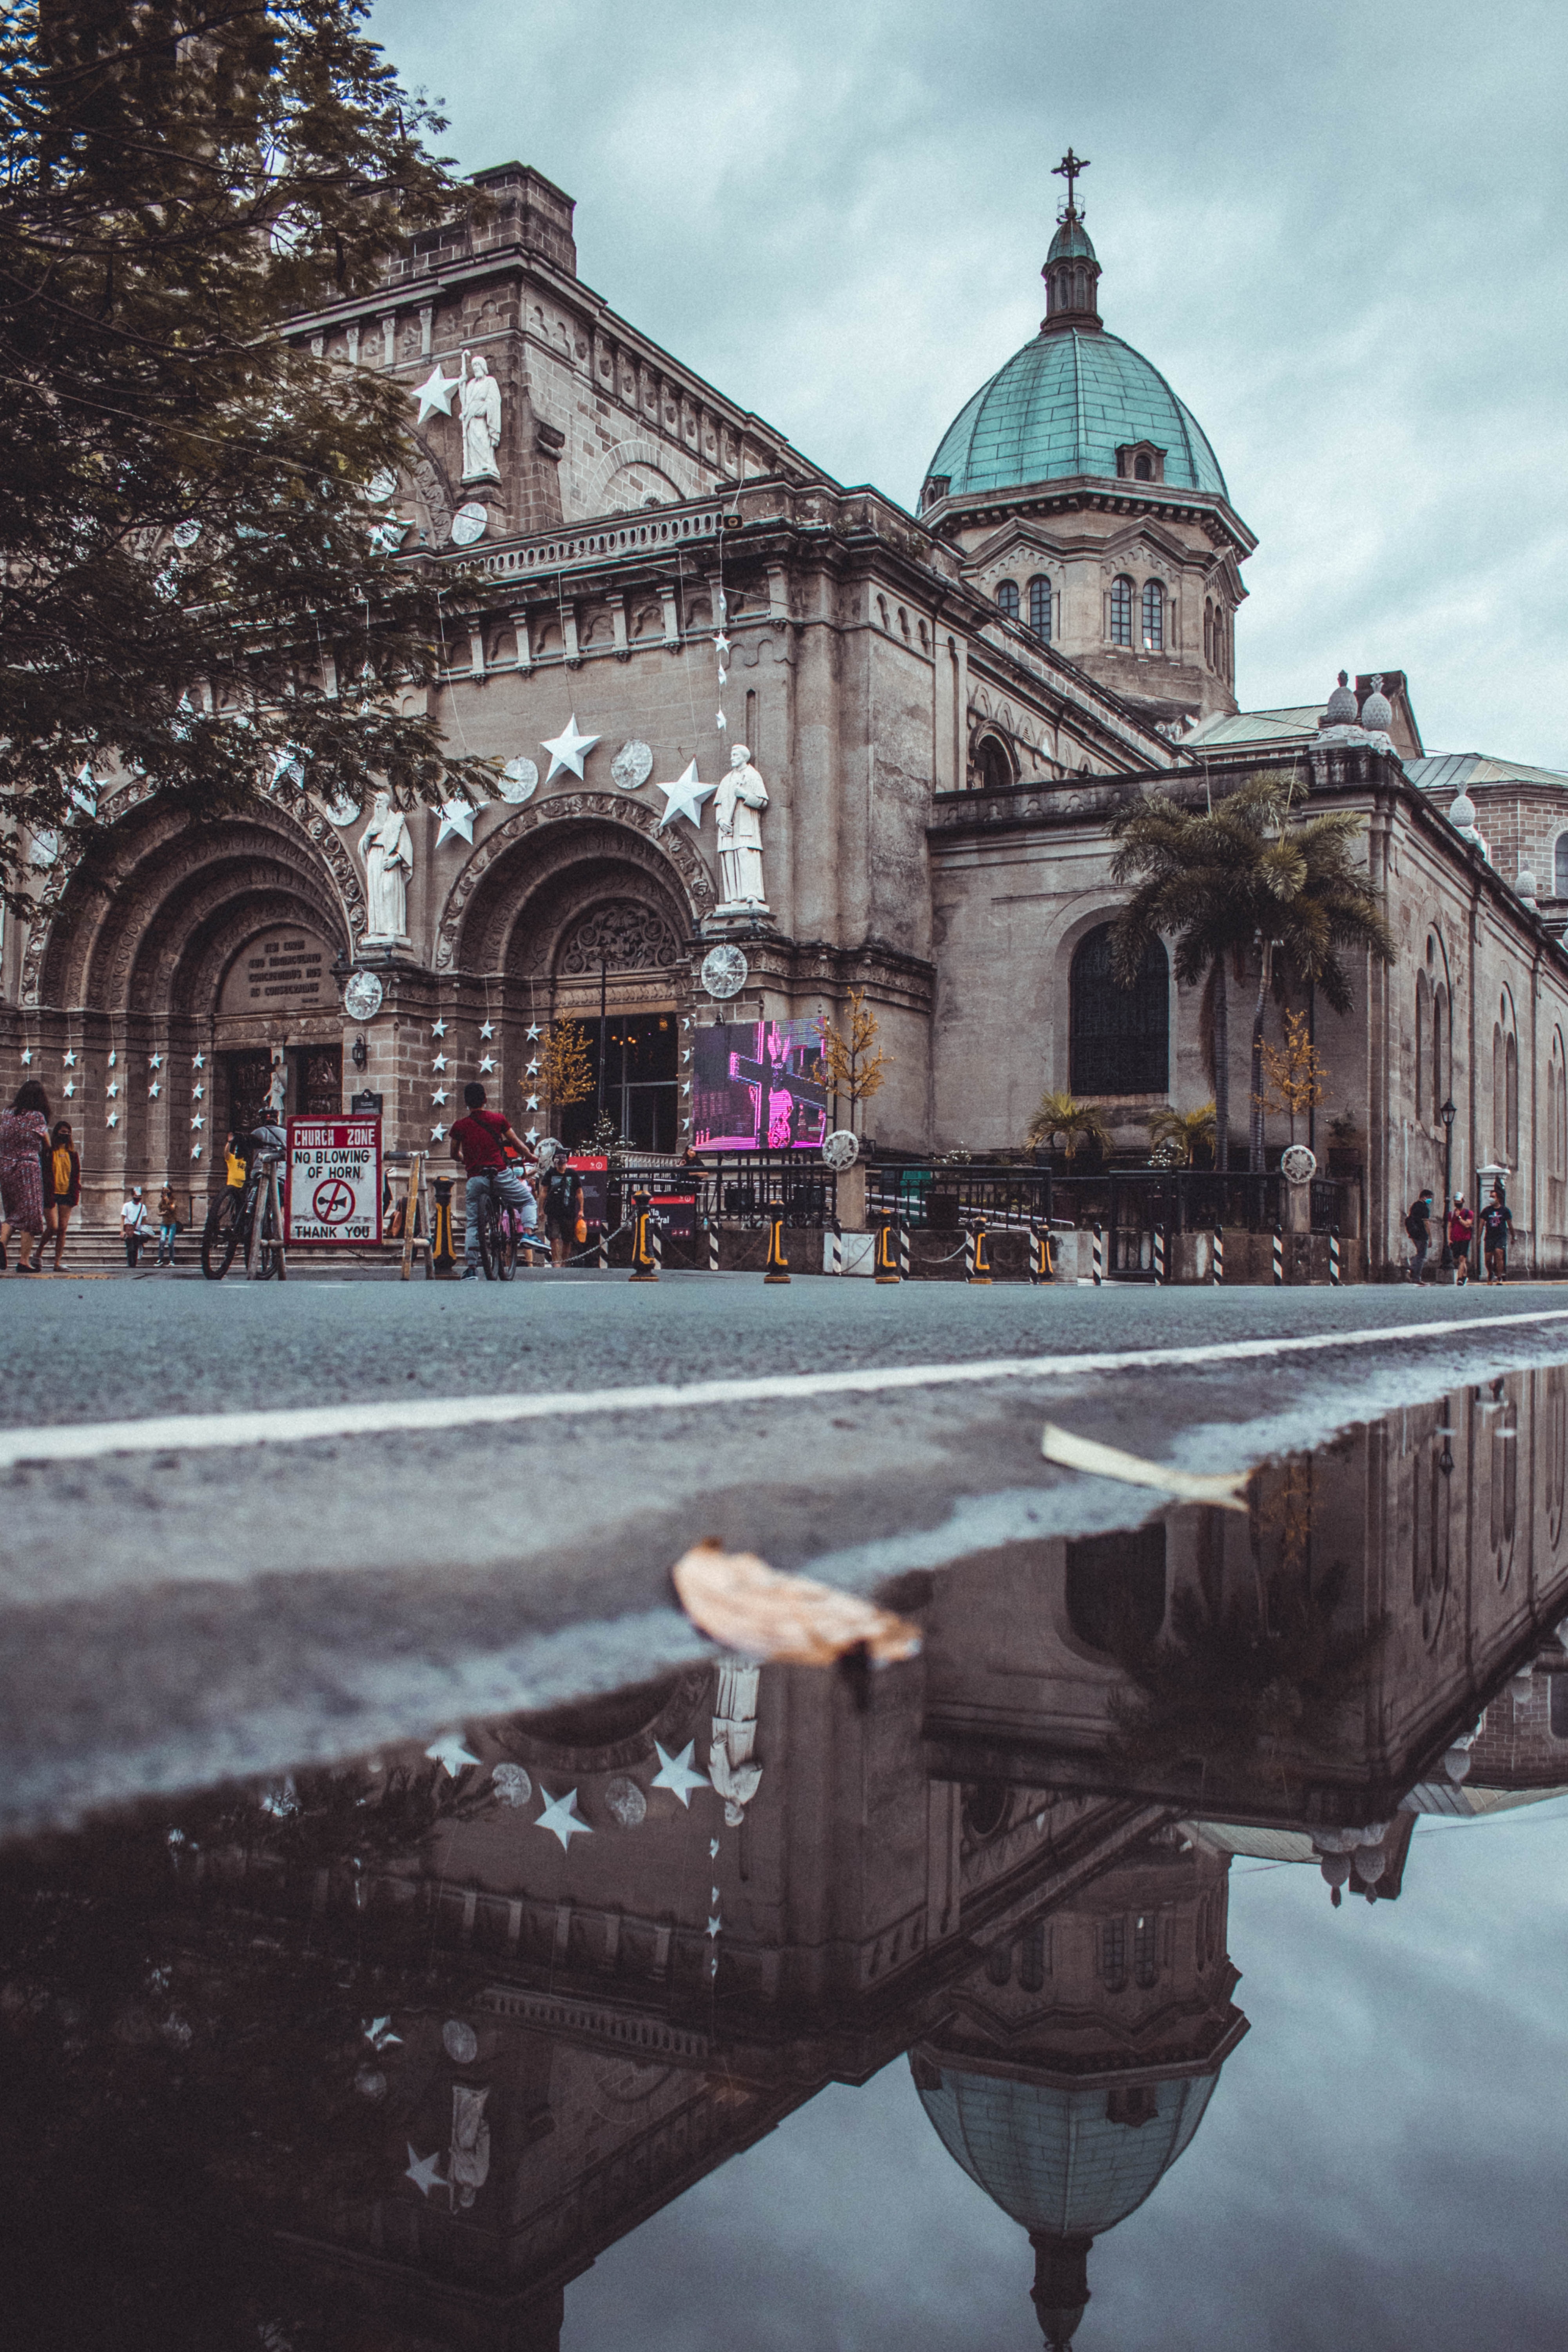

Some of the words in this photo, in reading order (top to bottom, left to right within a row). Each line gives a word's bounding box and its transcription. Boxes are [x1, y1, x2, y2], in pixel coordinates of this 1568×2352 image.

[294, 1130, 334, 1146] CHURCH
[347, 1129, 375, 1145] ZONE
[295, 1151, 310, 1163] NO
[316, 1150, 370, 1163] BLOWING
[308, 1167, 323, 1178] OF
[329, 1166, 360, 1178] HORN
[295, 1226, 337, 1238] THANK
[345, 1226, 370, 1238] YOU
